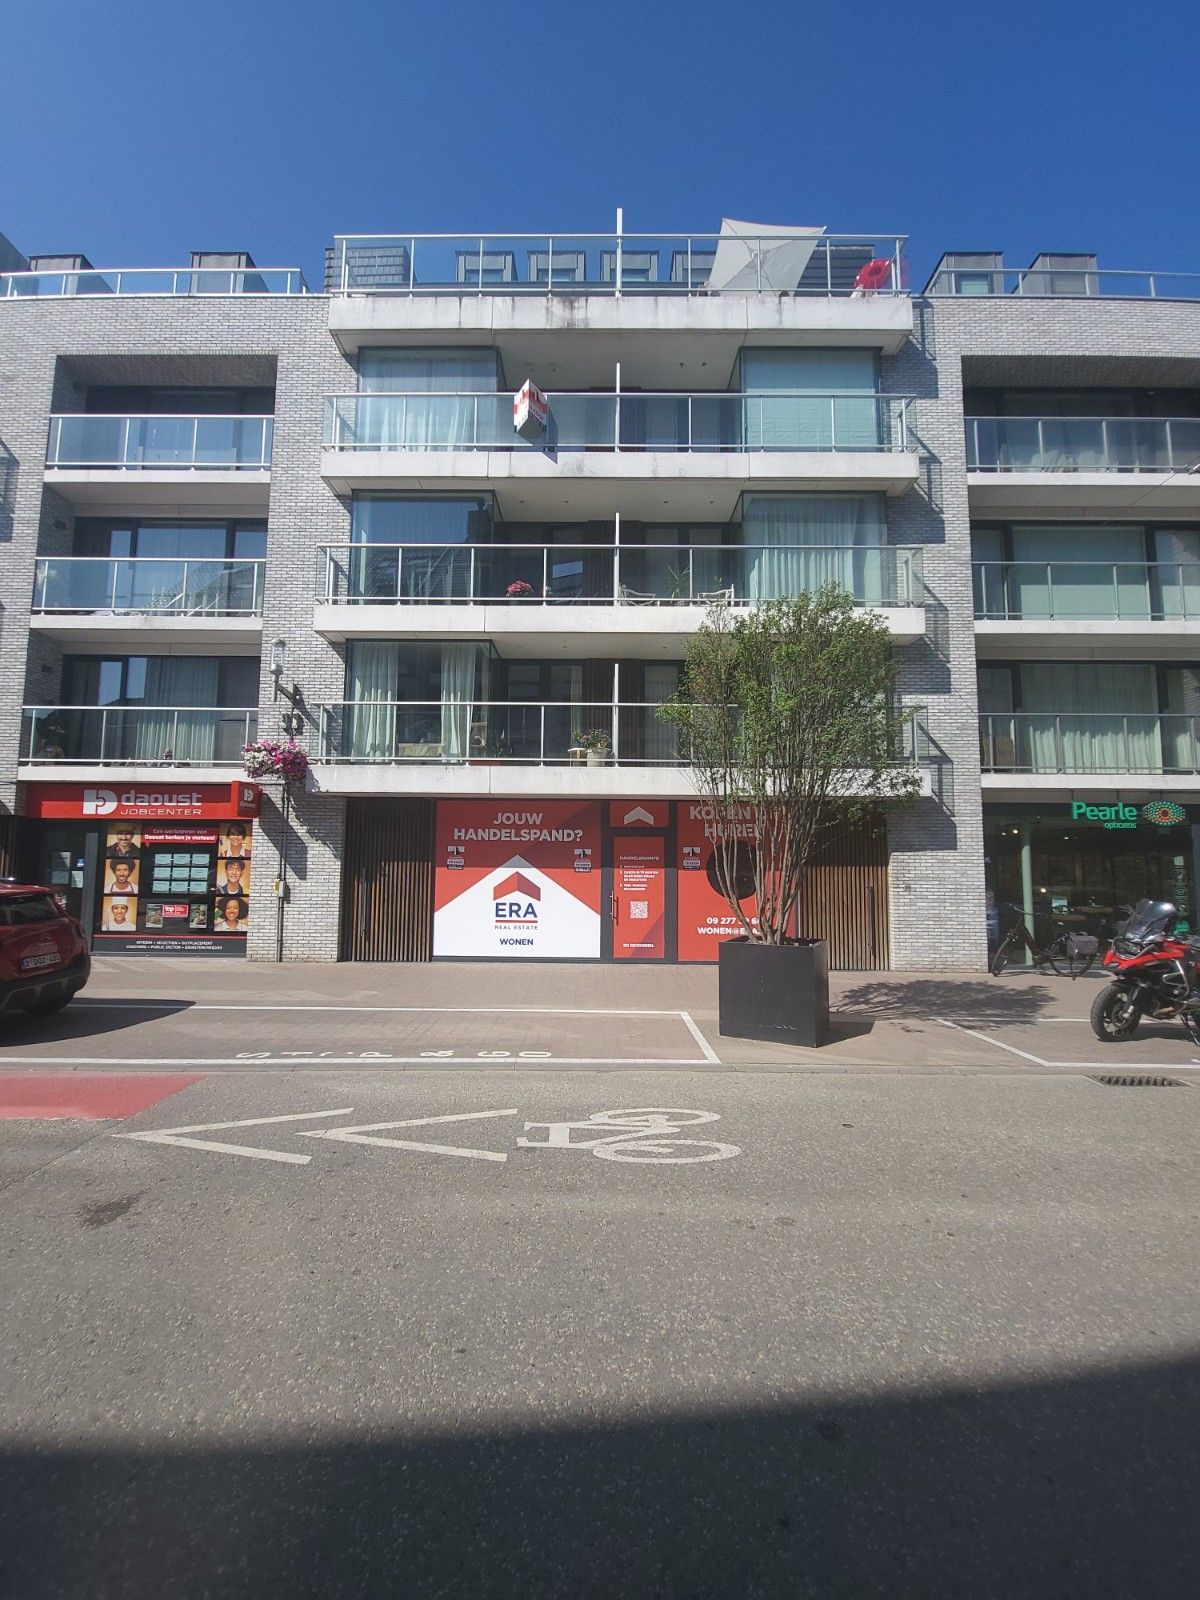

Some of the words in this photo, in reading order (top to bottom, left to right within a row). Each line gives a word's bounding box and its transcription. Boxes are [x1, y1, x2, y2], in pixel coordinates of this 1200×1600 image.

[121, 790, 202, 806] daoust
[121, 808, 202, 816] JOBCENTER
[1074, 802, 1138, 820] Pearle
[494, 813, 543, 825] JOUW
[1104, 822, 1138, 830] opticiens
[454, 829, 583, 842] HANDELSPAND?
[495, 902, 538, 918] ERA
[499, 938, 534, 946] WONEN
